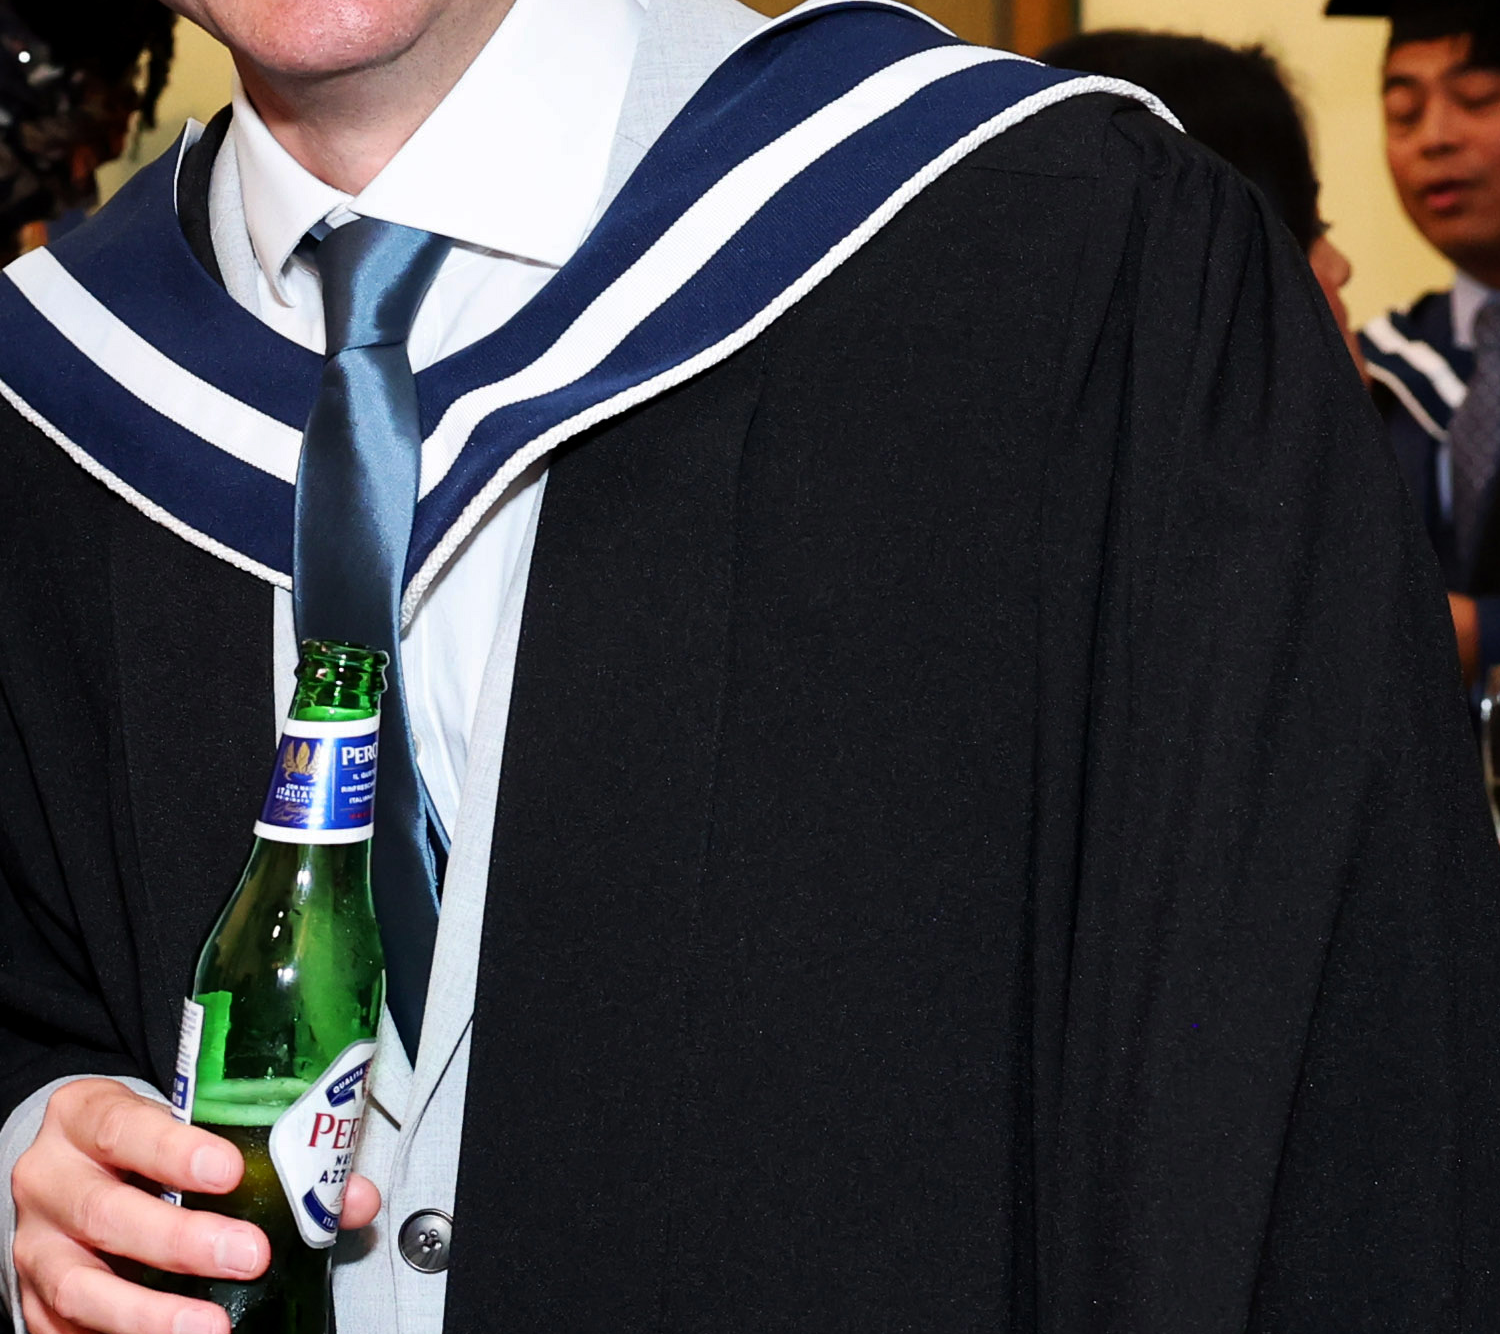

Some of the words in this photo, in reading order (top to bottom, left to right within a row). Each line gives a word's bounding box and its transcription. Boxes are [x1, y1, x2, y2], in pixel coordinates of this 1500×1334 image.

[341, 742, 378, 766] PERO
[307, 1112, 360, 1149] PER
[319, 1170, 346, 1184] AZZ
